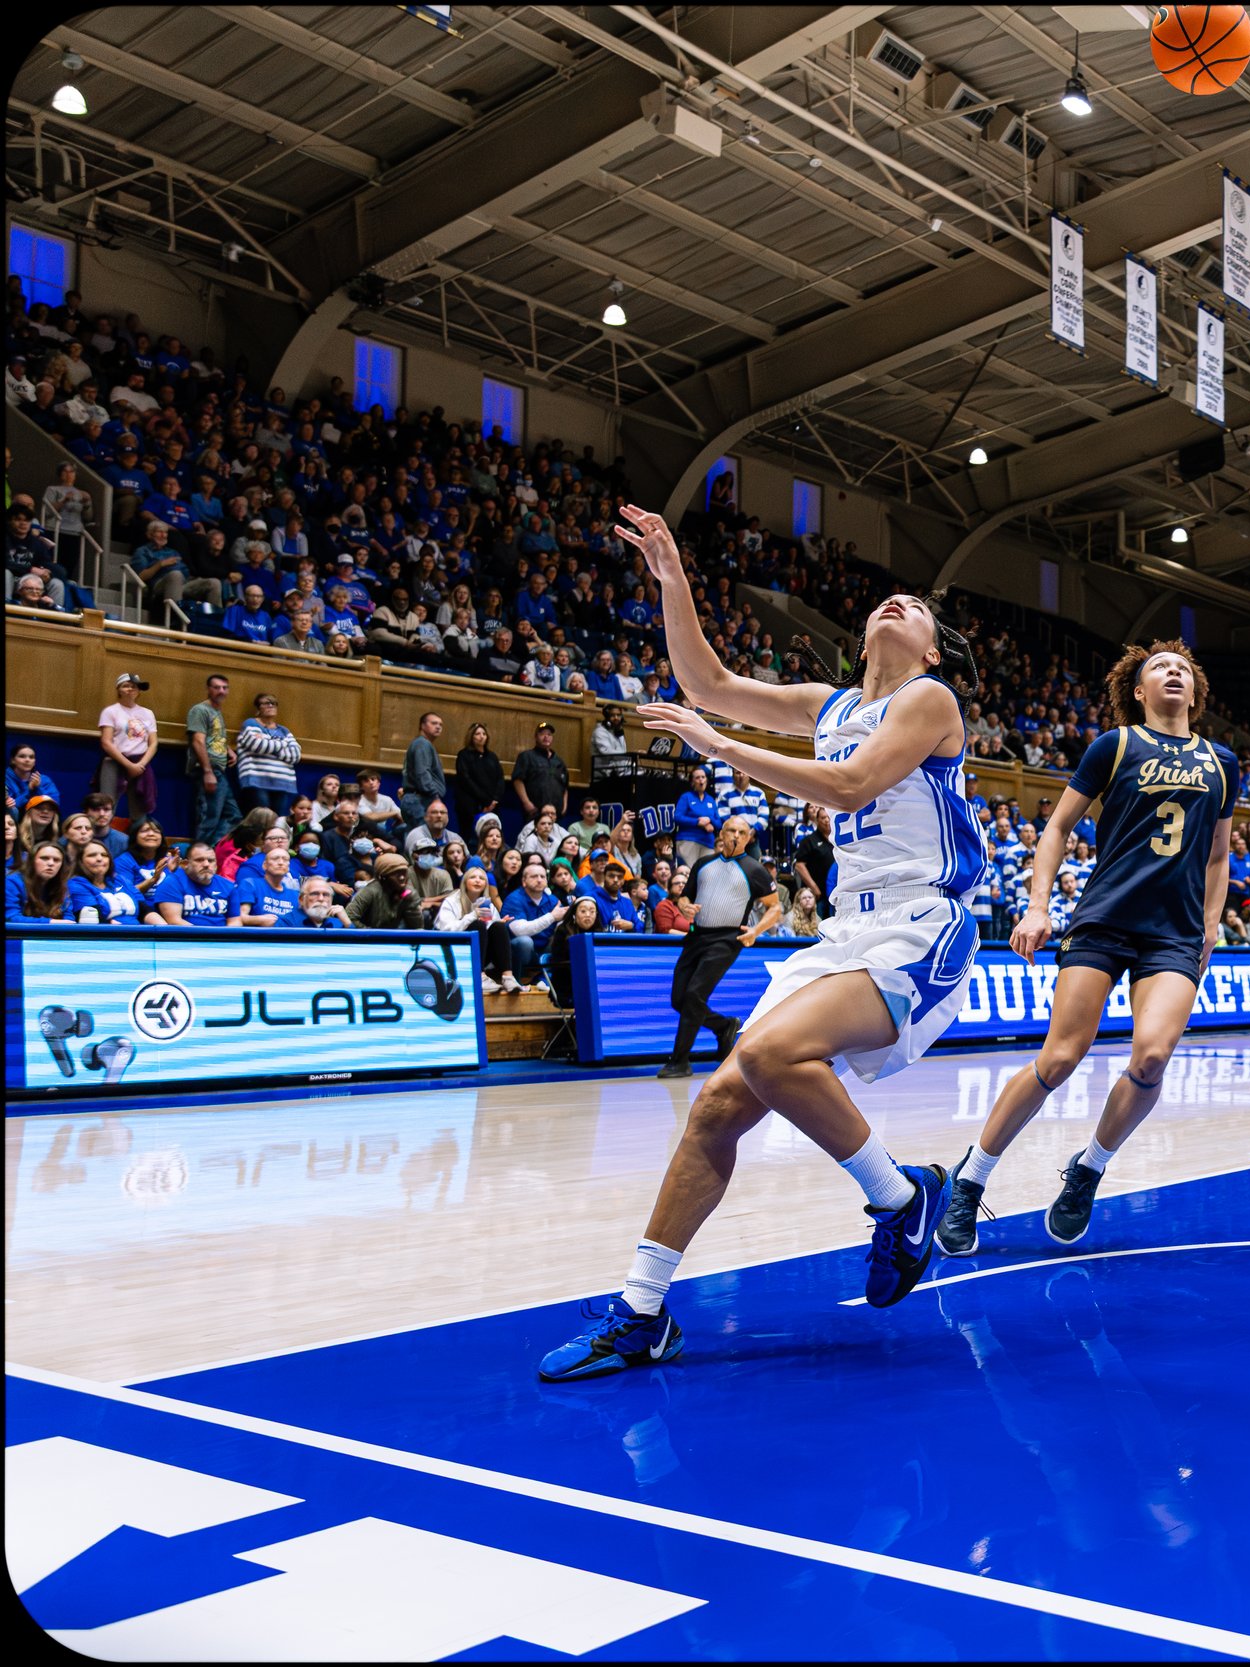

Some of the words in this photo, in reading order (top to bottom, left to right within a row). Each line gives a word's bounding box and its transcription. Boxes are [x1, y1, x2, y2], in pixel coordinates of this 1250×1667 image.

[1138, 758, 1209, 791] Irish
[834, 799, 883, 847] 22
[1150, 802, 1186, 857] 3
[184, 894, 228, 914] DUKE
[205, 990, 403, 1027] JLAB
[958, 964, 1060, 1022] DUK
[310, 1072, 352, 1081] DAKTRONICS
